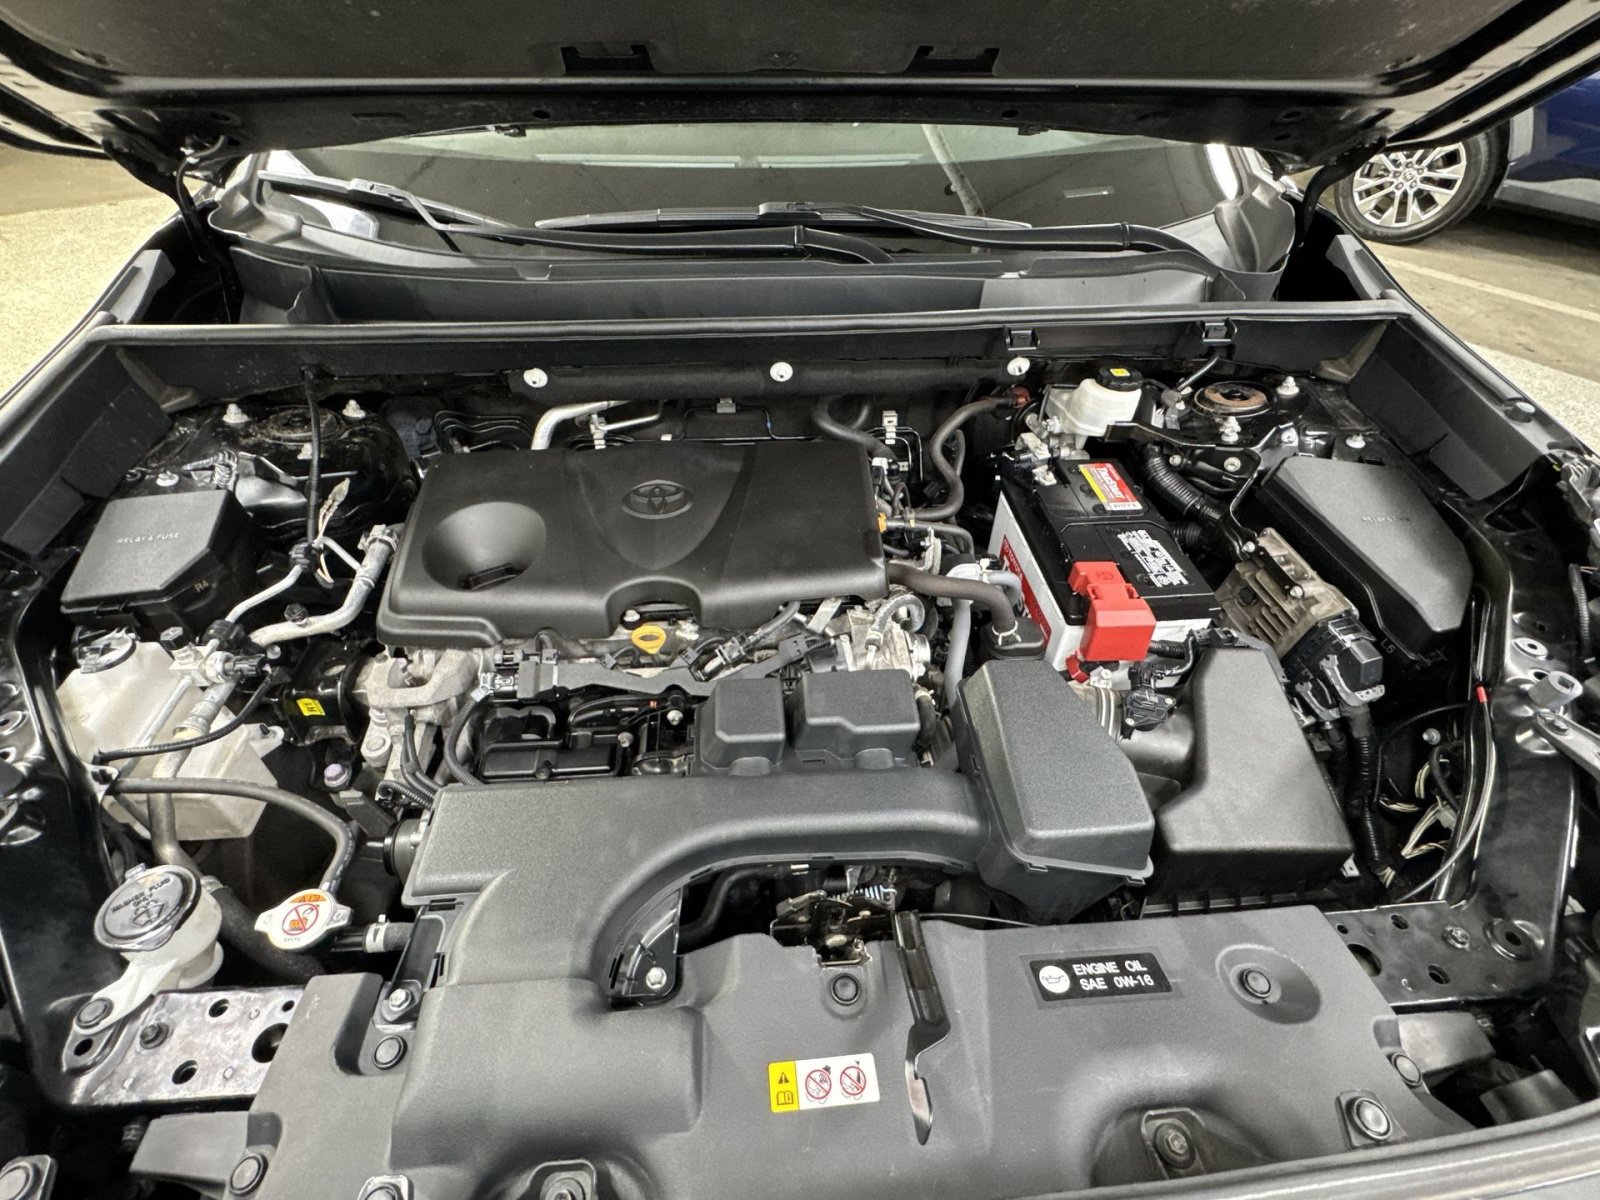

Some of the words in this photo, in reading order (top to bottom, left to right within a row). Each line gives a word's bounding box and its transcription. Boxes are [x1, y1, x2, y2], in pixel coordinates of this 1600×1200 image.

[149, 878, 171, 893] FLUID
[1072, 961, 1120, 976] ENGINE
[1125, 960, 1148, 972] OIL
[1079, 977, 1108, 991] SAE
[1113, 974, 1154, 988] 0W-16
